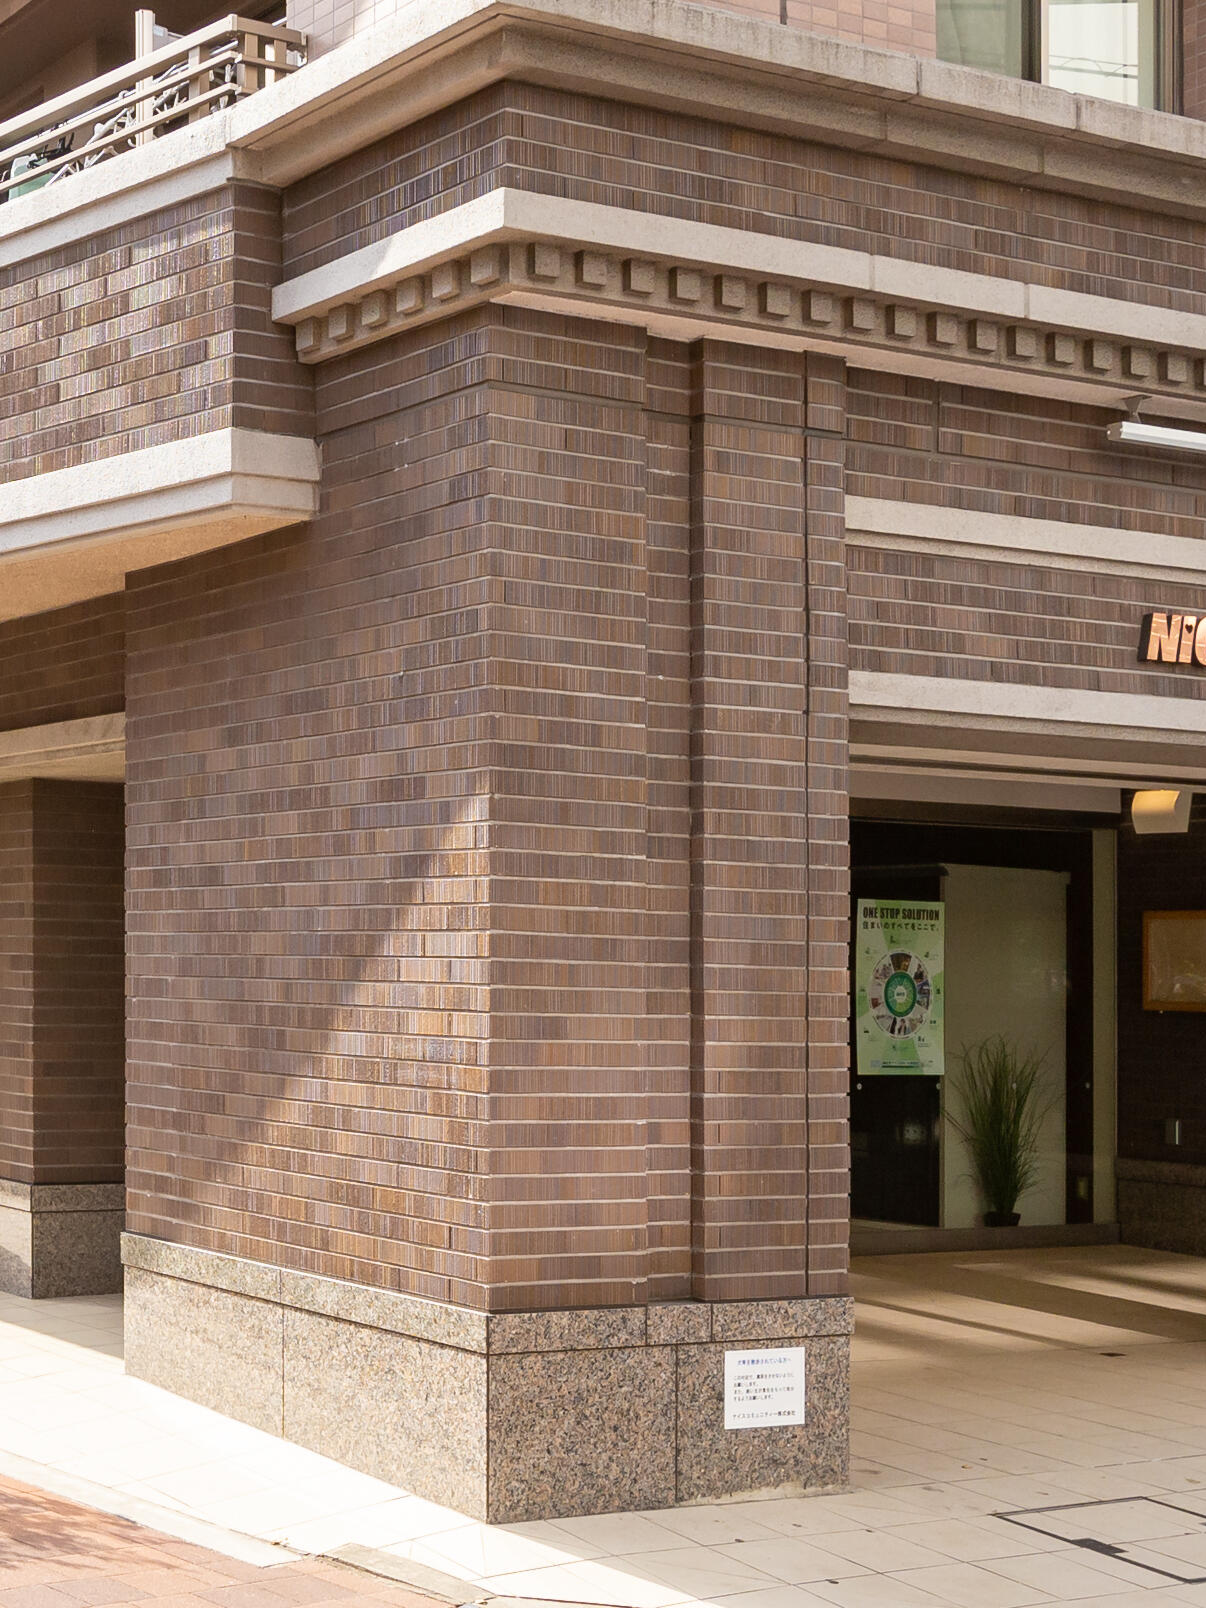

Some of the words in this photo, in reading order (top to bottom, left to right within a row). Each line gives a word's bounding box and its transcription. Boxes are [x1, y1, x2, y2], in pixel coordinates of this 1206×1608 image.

[862, 906, 878, 919] ONE
[880, 907, 900, 920] STOP
[902, 908, 940, 921] SOLUTION
